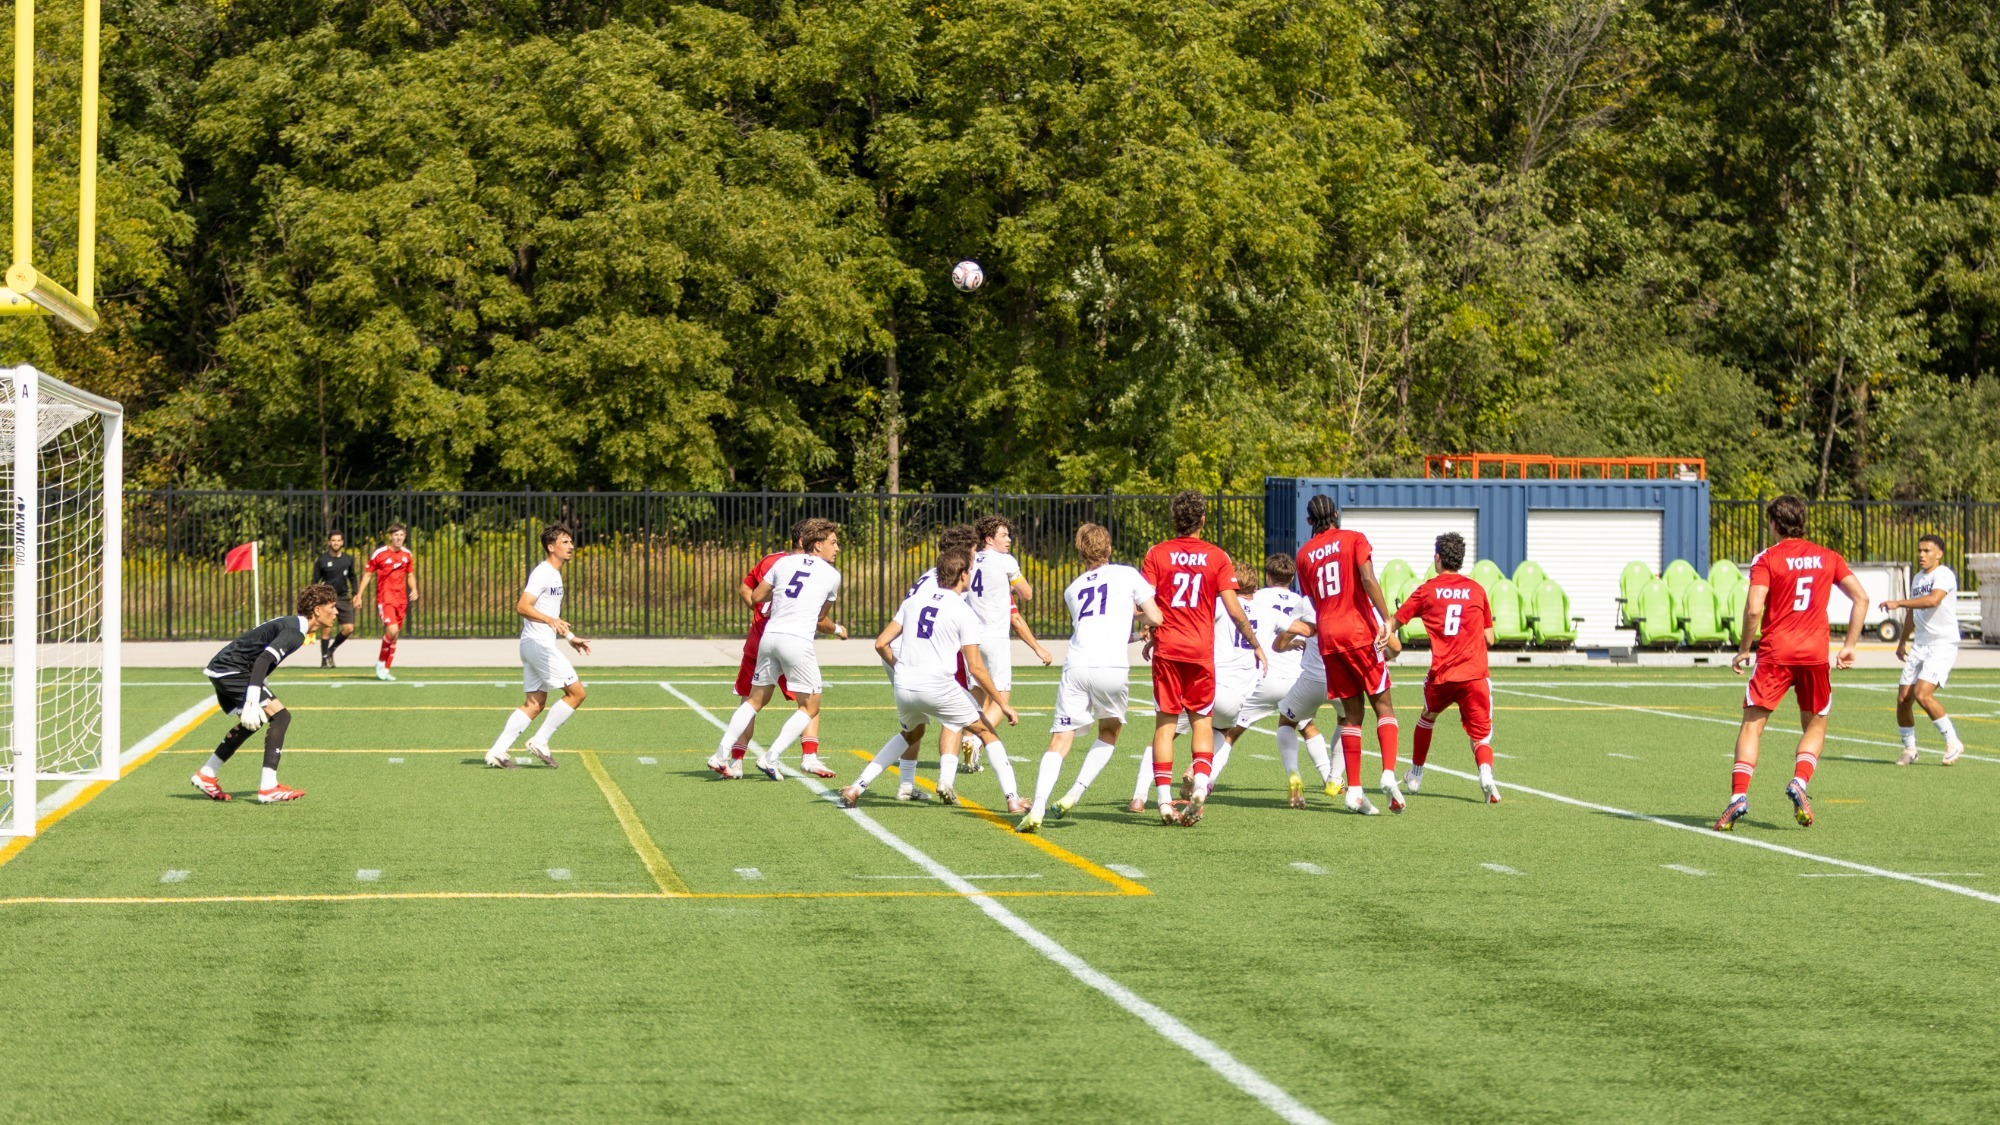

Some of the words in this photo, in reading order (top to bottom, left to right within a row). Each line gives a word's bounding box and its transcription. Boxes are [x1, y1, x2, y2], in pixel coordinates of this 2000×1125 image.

[22, 383, 29, 398] A
[1169, 551, 1208, 567] YORK
[1307, 540, 1341, 564] YORK
[1785, 555, 1823, 571] YORK
[784, 570, 811, 599] 5
[1170, 572, 1203, 608] 21
[1316, 561, 1341, 599] 19
[1435, 587, 1471, 600] YORK
[1792, 575, 1814, 612] 5
[1077, 583, 1108, 622] 21
[916, 605, 939, 640] 6
[1443, 603, 1463, 636] 6
